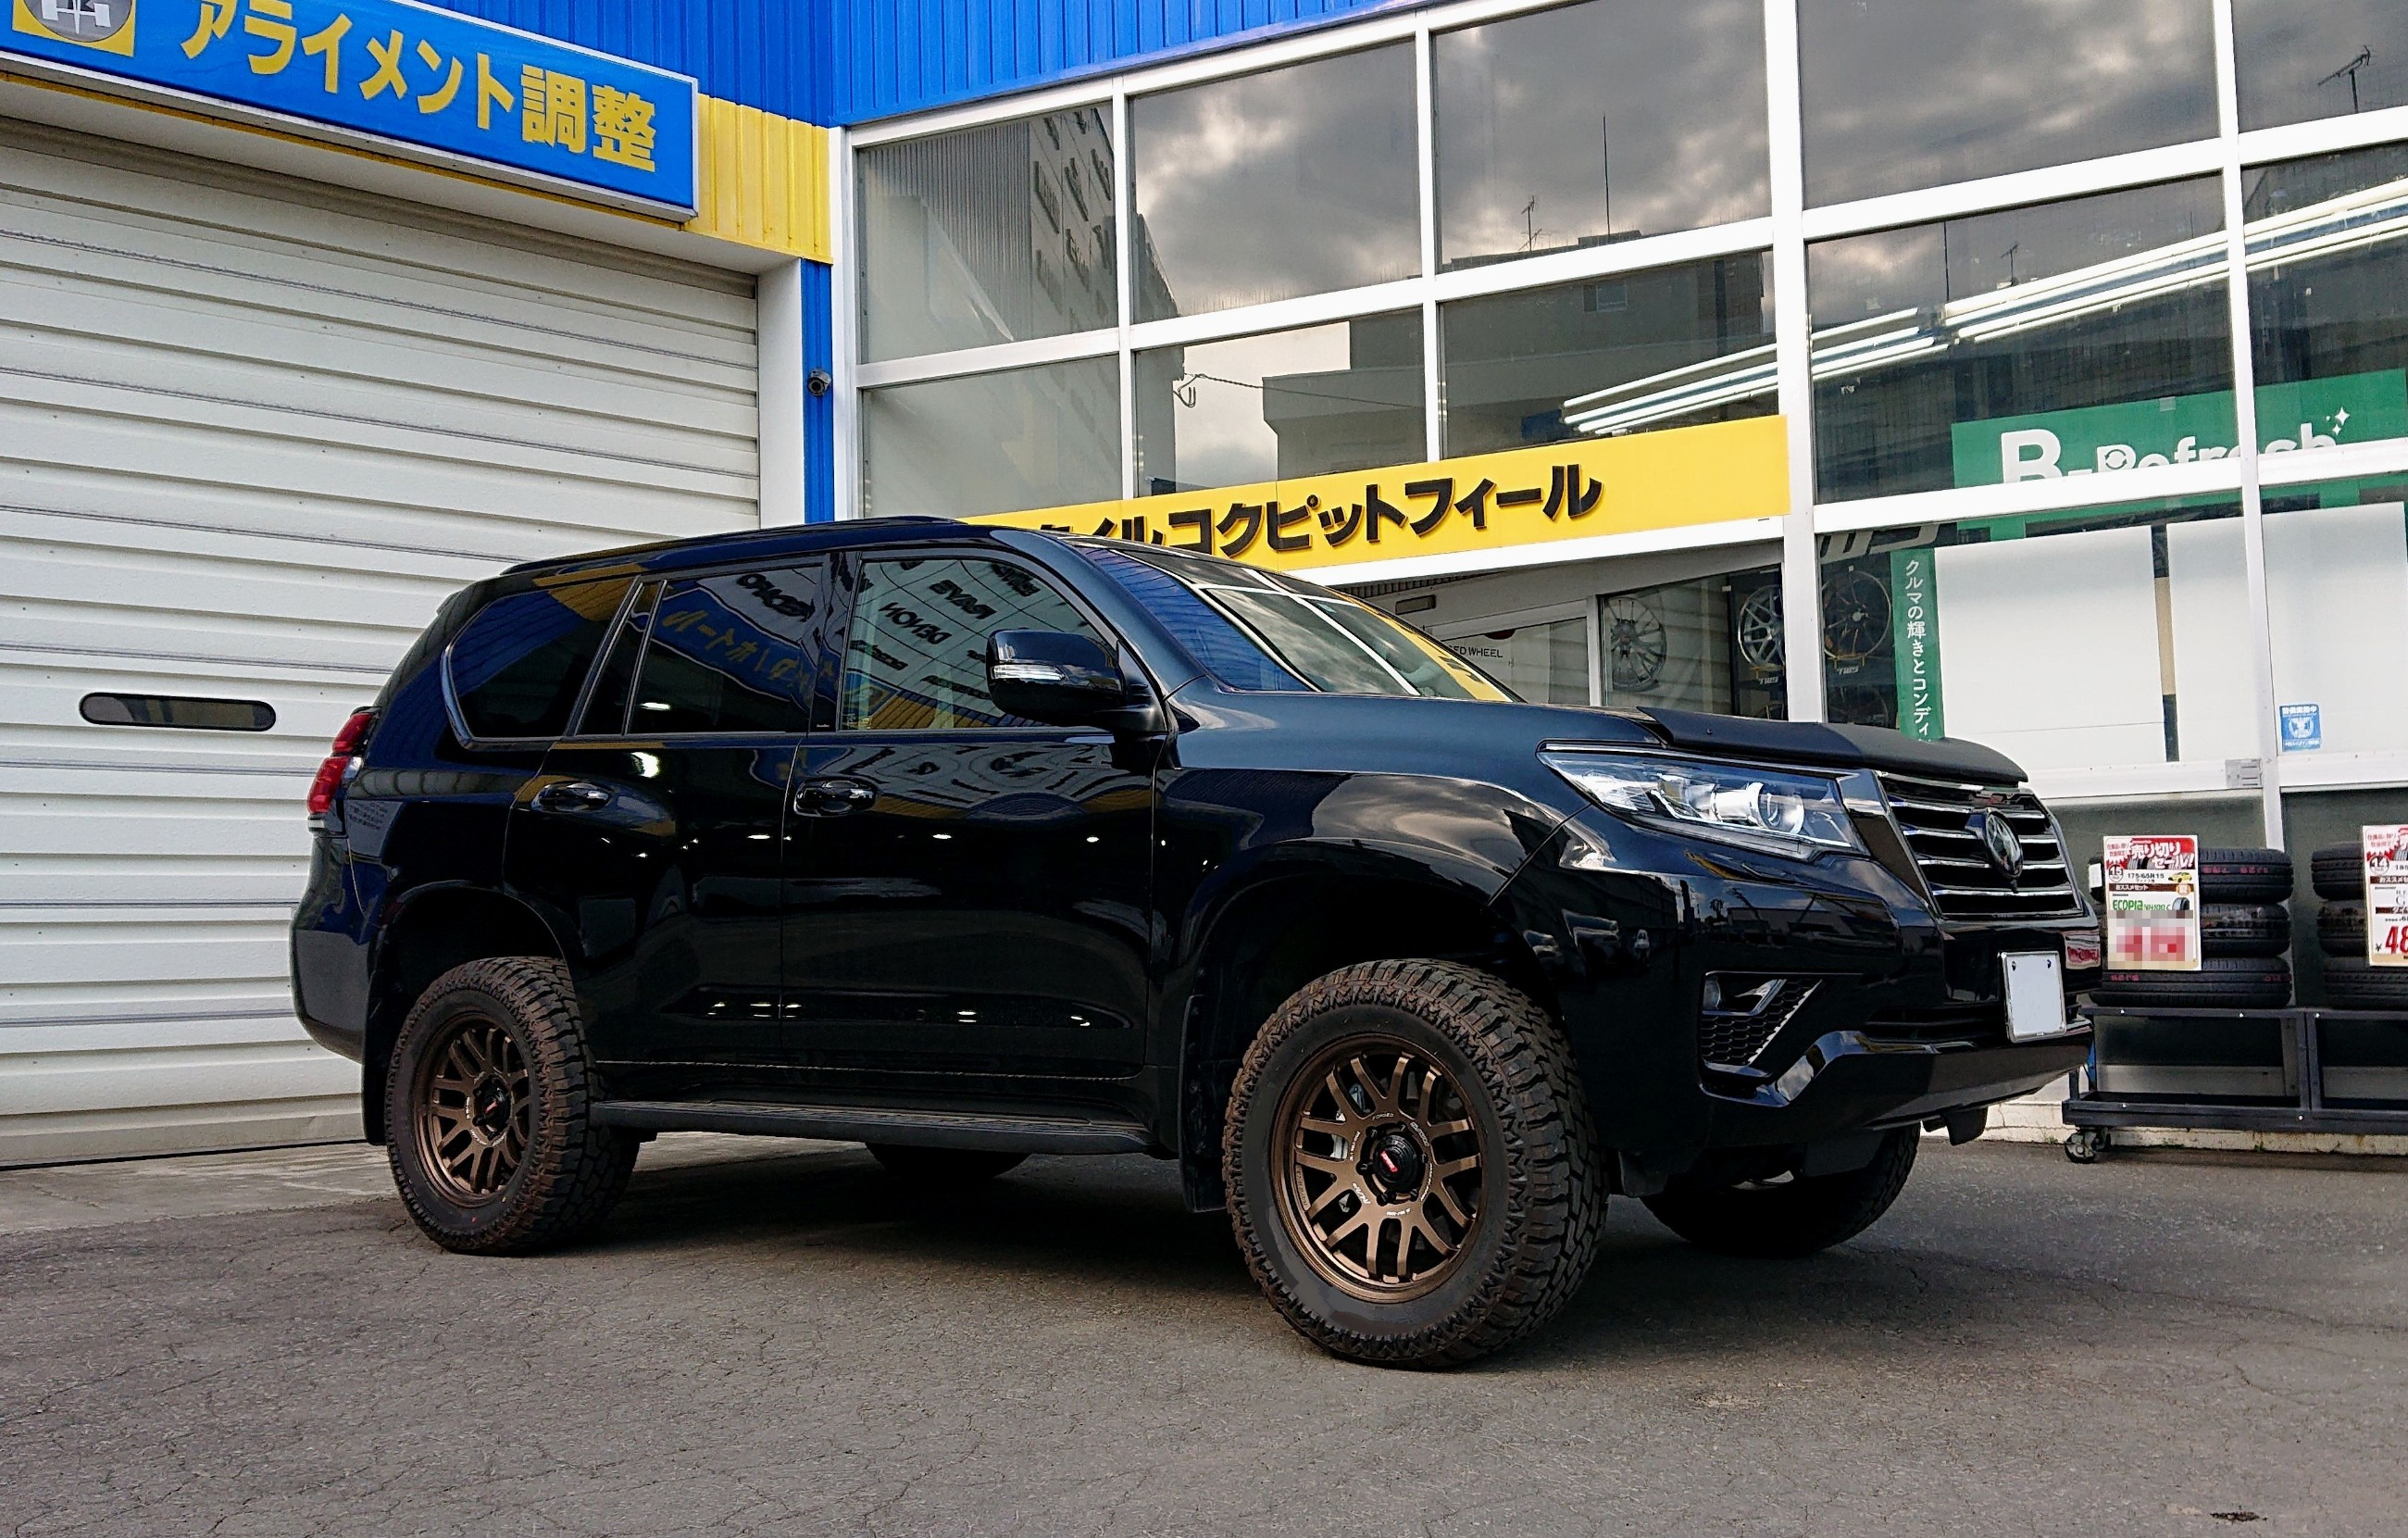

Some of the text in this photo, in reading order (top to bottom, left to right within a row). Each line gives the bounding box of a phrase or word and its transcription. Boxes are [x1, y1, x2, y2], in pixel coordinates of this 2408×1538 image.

[180, 0, 655, 173] アライメント調整
[1468, 646, 1503, 658] WHEEL
[1905, 559, 1932, 742] クルマの輝きとコンディ
[2130, 842, 2181, 859] 売り切り
[2371, 857, 2389, 868] 14
